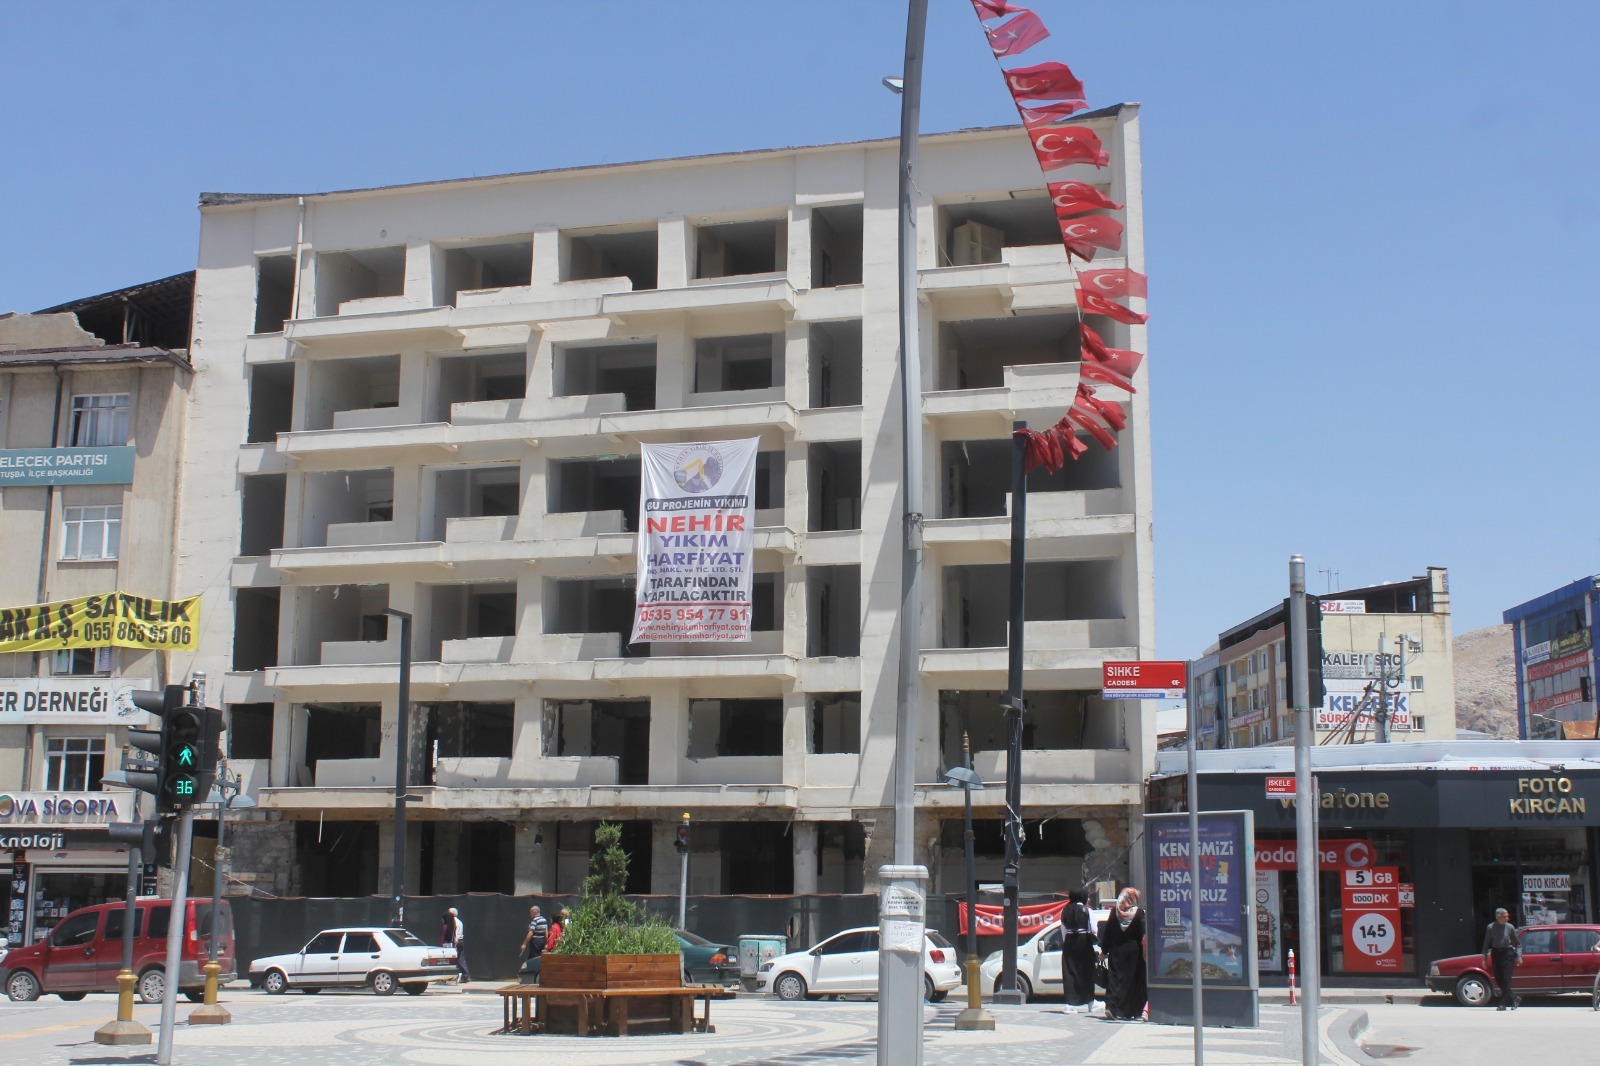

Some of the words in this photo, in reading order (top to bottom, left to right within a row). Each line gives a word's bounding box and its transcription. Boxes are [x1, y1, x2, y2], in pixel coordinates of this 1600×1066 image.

[0, 455, 53, 468] ELECEK
[0, 471, 25, 479] TUŞBA
[28, 469, 45, 479] İLÇE
[647, 501, 660, 510] BU
[662, 498, 711, 510] PROJENİN
[714, 498, 746, 508] YIKIMI
[646, 509, 745, 534] NEHİR
[659, 535, 728, 547] YIKIM
[647, 549, 745, 566] HARFİYAT
[651, 577, 738, 589] TARAFINDAN
[644, 591, 746, 602] YAPILACAKTIR
[85, 594, 191, 622] SATILIK
[641, 609, 671, 622] 0535
[676, 609, 703, 620] 954
[709, 609, 726, 620] 77
[729, 609, 746, 620] 91
[34, 604, 78, 646] A.Ş.
[84, 622, 114, 642] 055
[117, 621, 144, 643] 863
[171, 625, 191, 644] 06
[1107, 666, 1140, 677] SIHKE
[176, 780, 193, 795] 36
[1518, 777, 1572, 793] FOTO
[1280, 788, 1390, 809] vafone
[43, 795, 119, 816] SİGORTA
[1509, 797, 1586, 814] KIRCAN
[1355, 871, 1365, 884] 5
[1374, 873, 1393, 884] GB
[1524, 878, 1542, 889] FOTO
[1544, 878, 1570, 888] KIRCAN
[1354, 895, 1373, 903] 1000
[1374, 894, 1389, 903] DK
[1359, 924, 1387, 939] 145
[1367, 944, 1382, 954] TL
